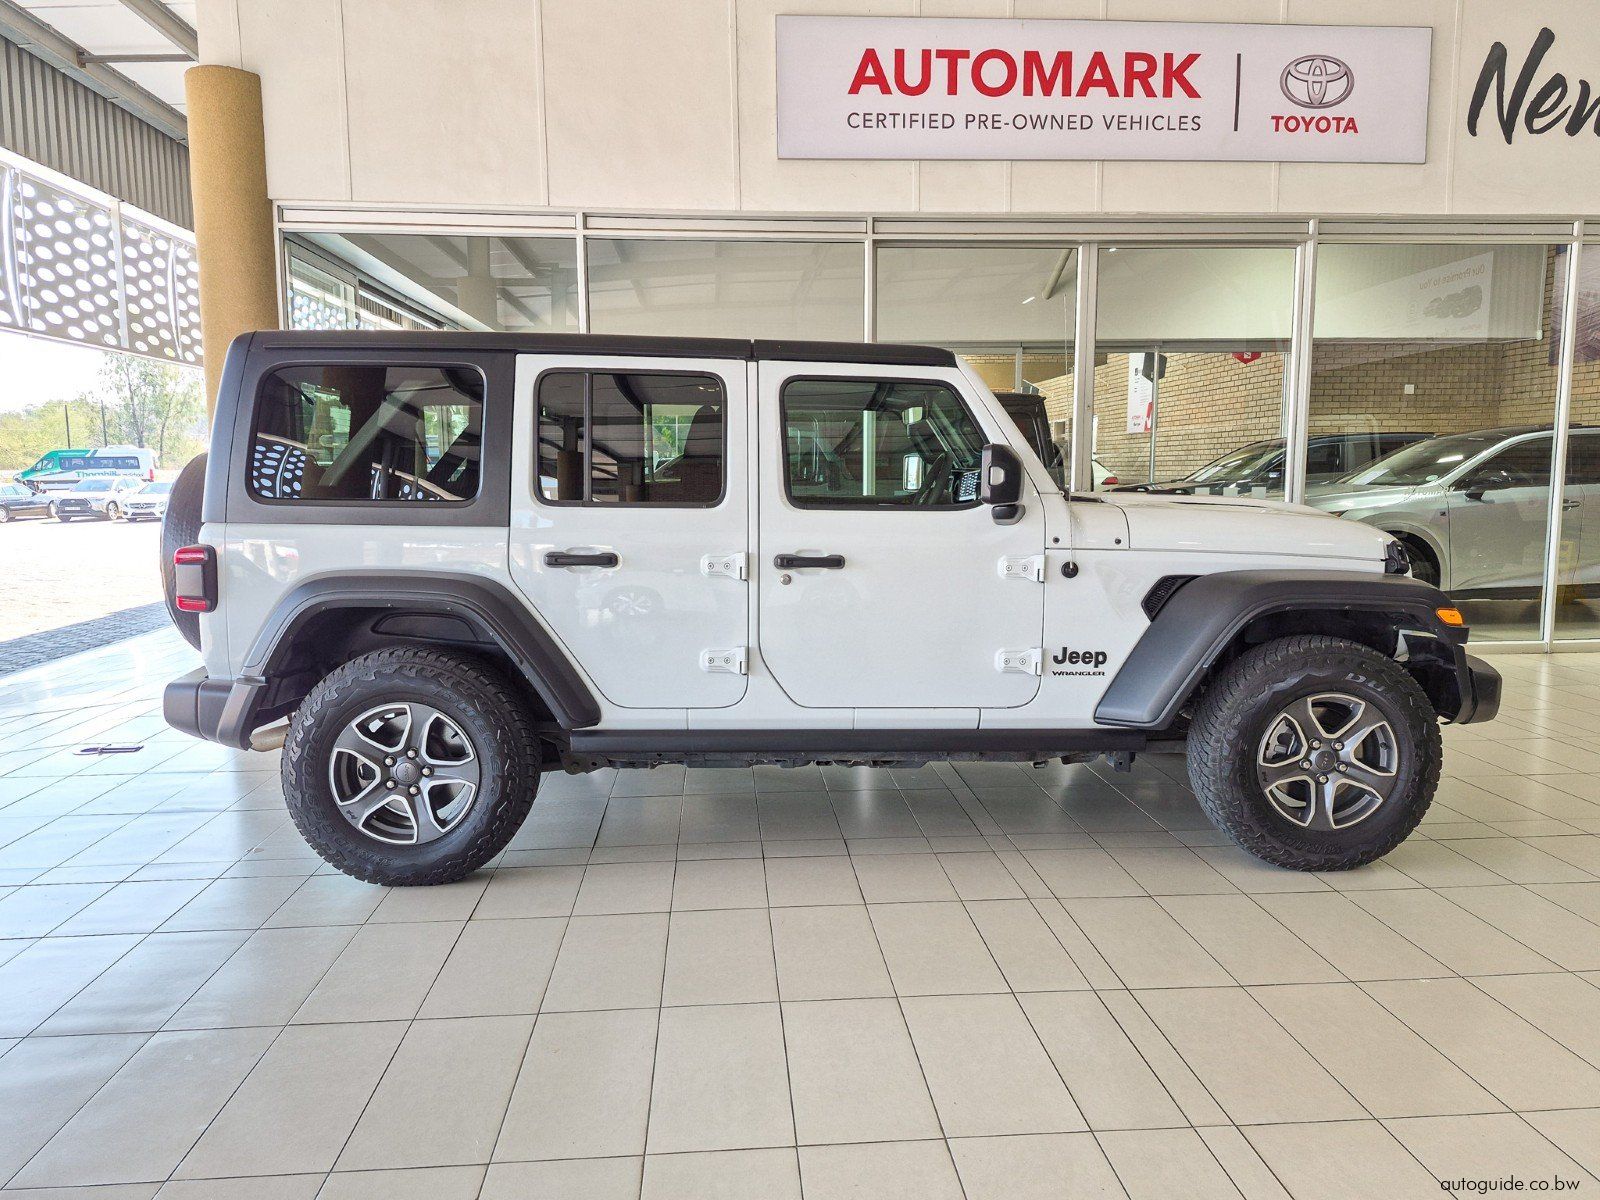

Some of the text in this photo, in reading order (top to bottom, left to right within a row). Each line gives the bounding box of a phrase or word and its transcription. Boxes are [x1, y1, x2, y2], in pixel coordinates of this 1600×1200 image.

[848, 48, 1202, 99] AUTOMARK
[847, 112, 1202, 132] CERTIFIED PRE-OWNED VEHICLES
[1270, 115, 1359, 134] TOYOTA
[1052, 646, 1108, 668] Jeep
